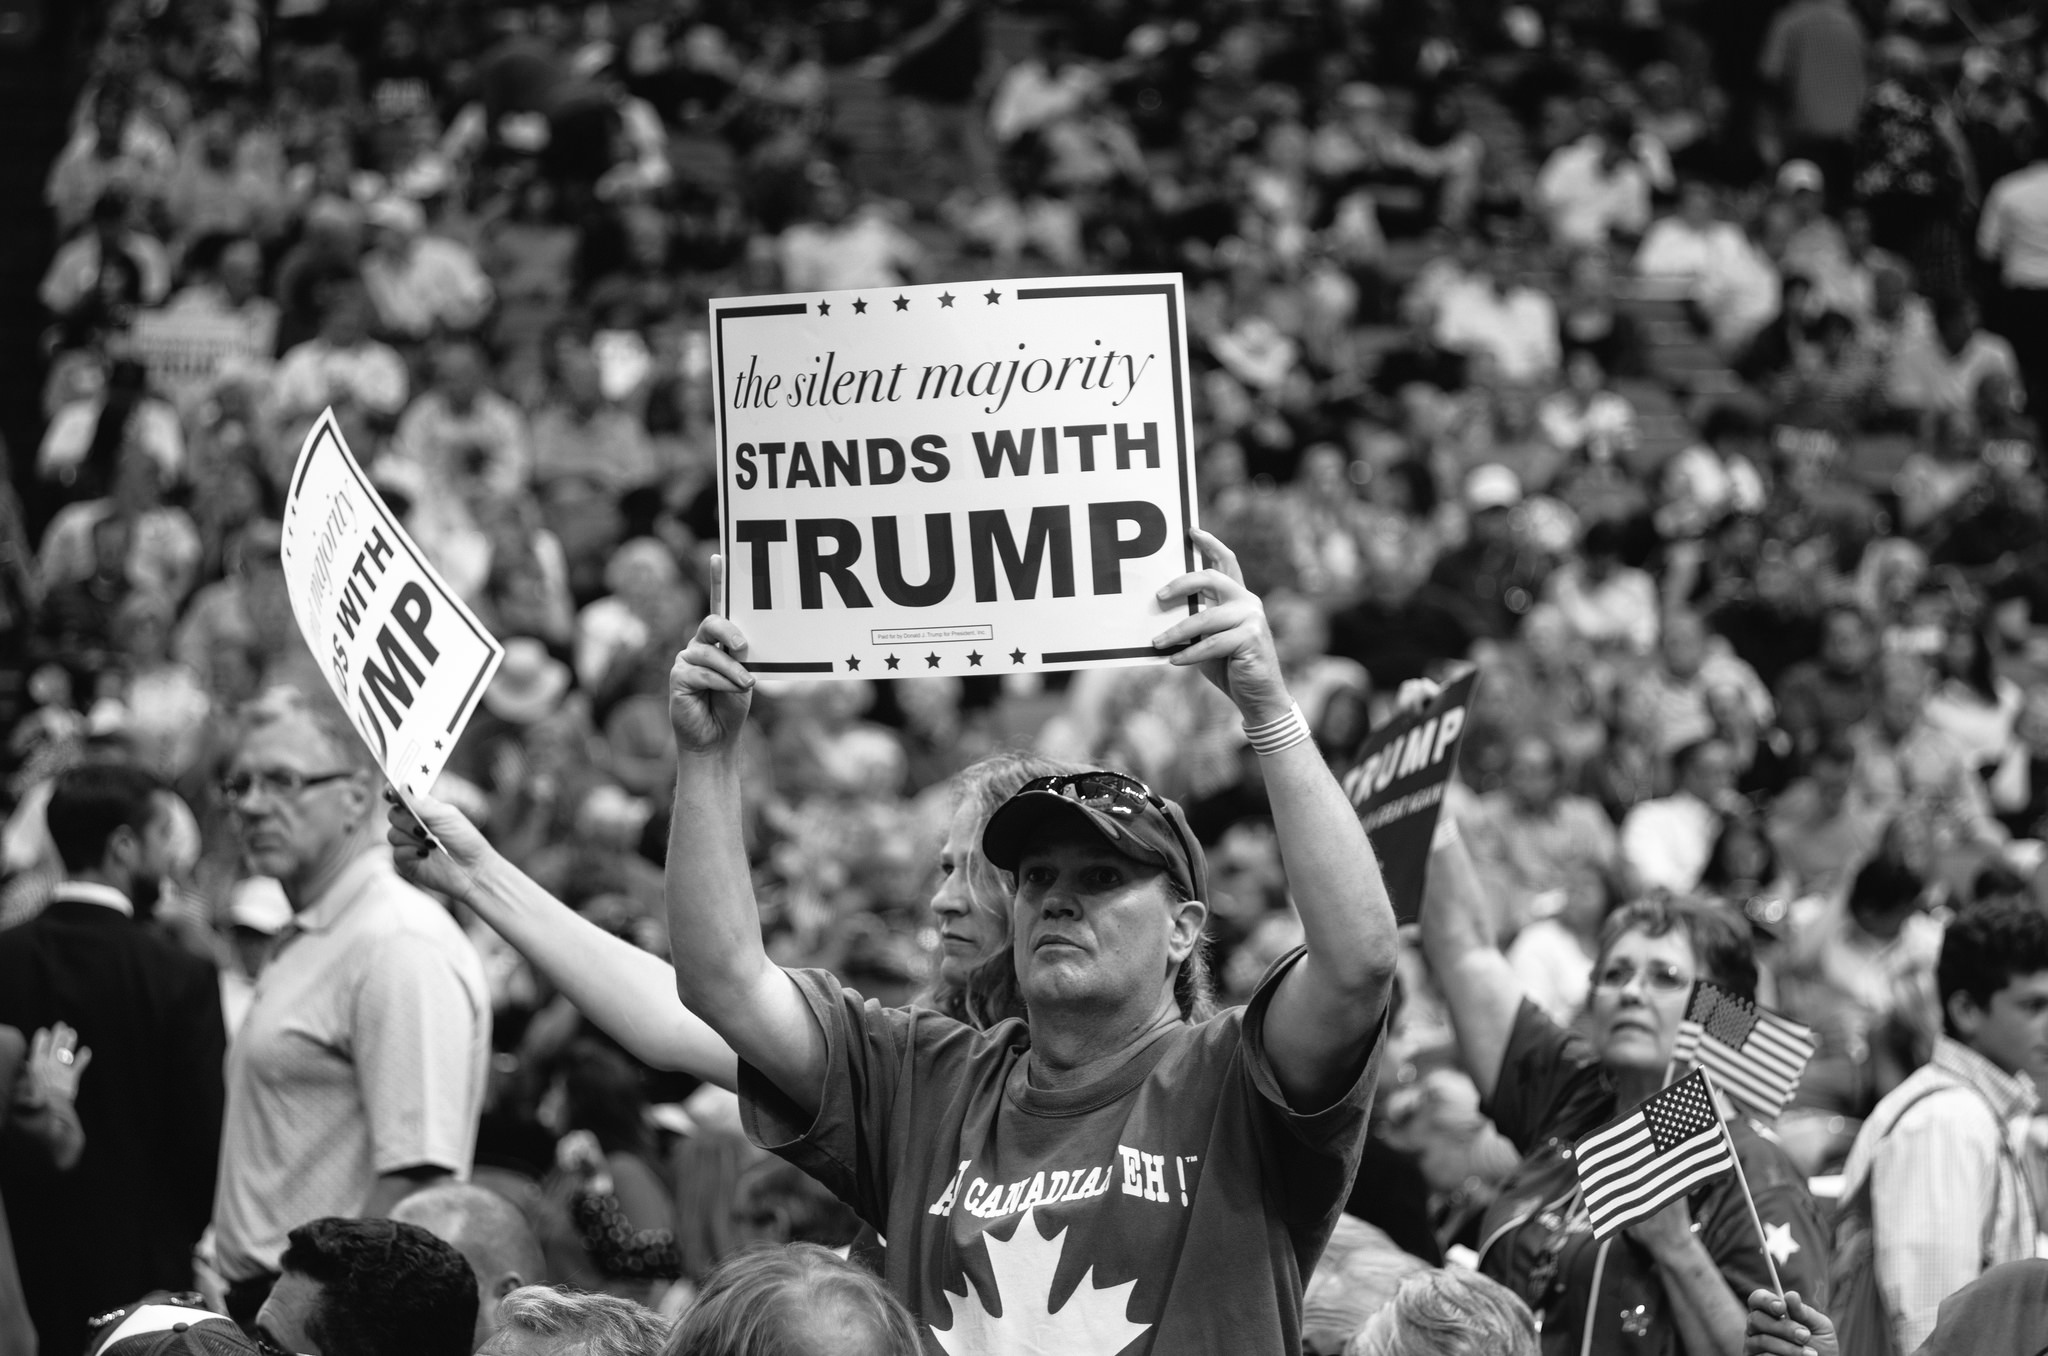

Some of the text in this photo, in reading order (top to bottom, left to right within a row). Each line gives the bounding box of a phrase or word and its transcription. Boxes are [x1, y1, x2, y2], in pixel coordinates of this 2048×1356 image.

[733, 339, 1155, 414] the silent majority
[735, 421, 1161, 490] STANDS WITH
[336, 525, 394, 641] WITH
[736, 500, 1168, 611] TRUMP
[927, 631, 942, 639] Trump
